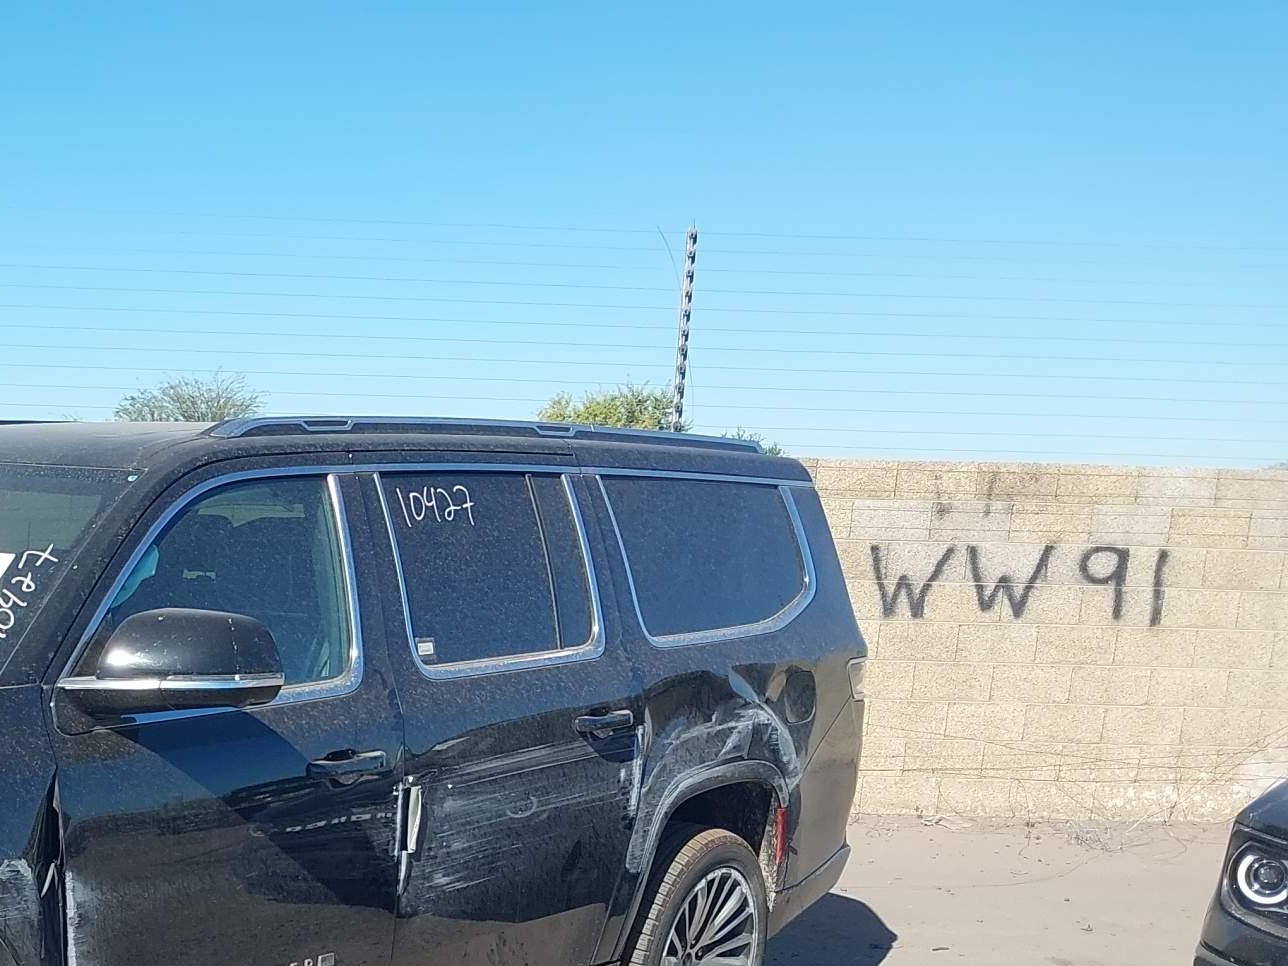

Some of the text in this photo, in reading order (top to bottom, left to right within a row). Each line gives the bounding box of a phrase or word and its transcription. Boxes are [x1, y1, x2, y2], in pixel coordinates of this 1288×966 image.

[396, 486, 475, 527] 10427
[869, 543, 1169, 627] WW 91
